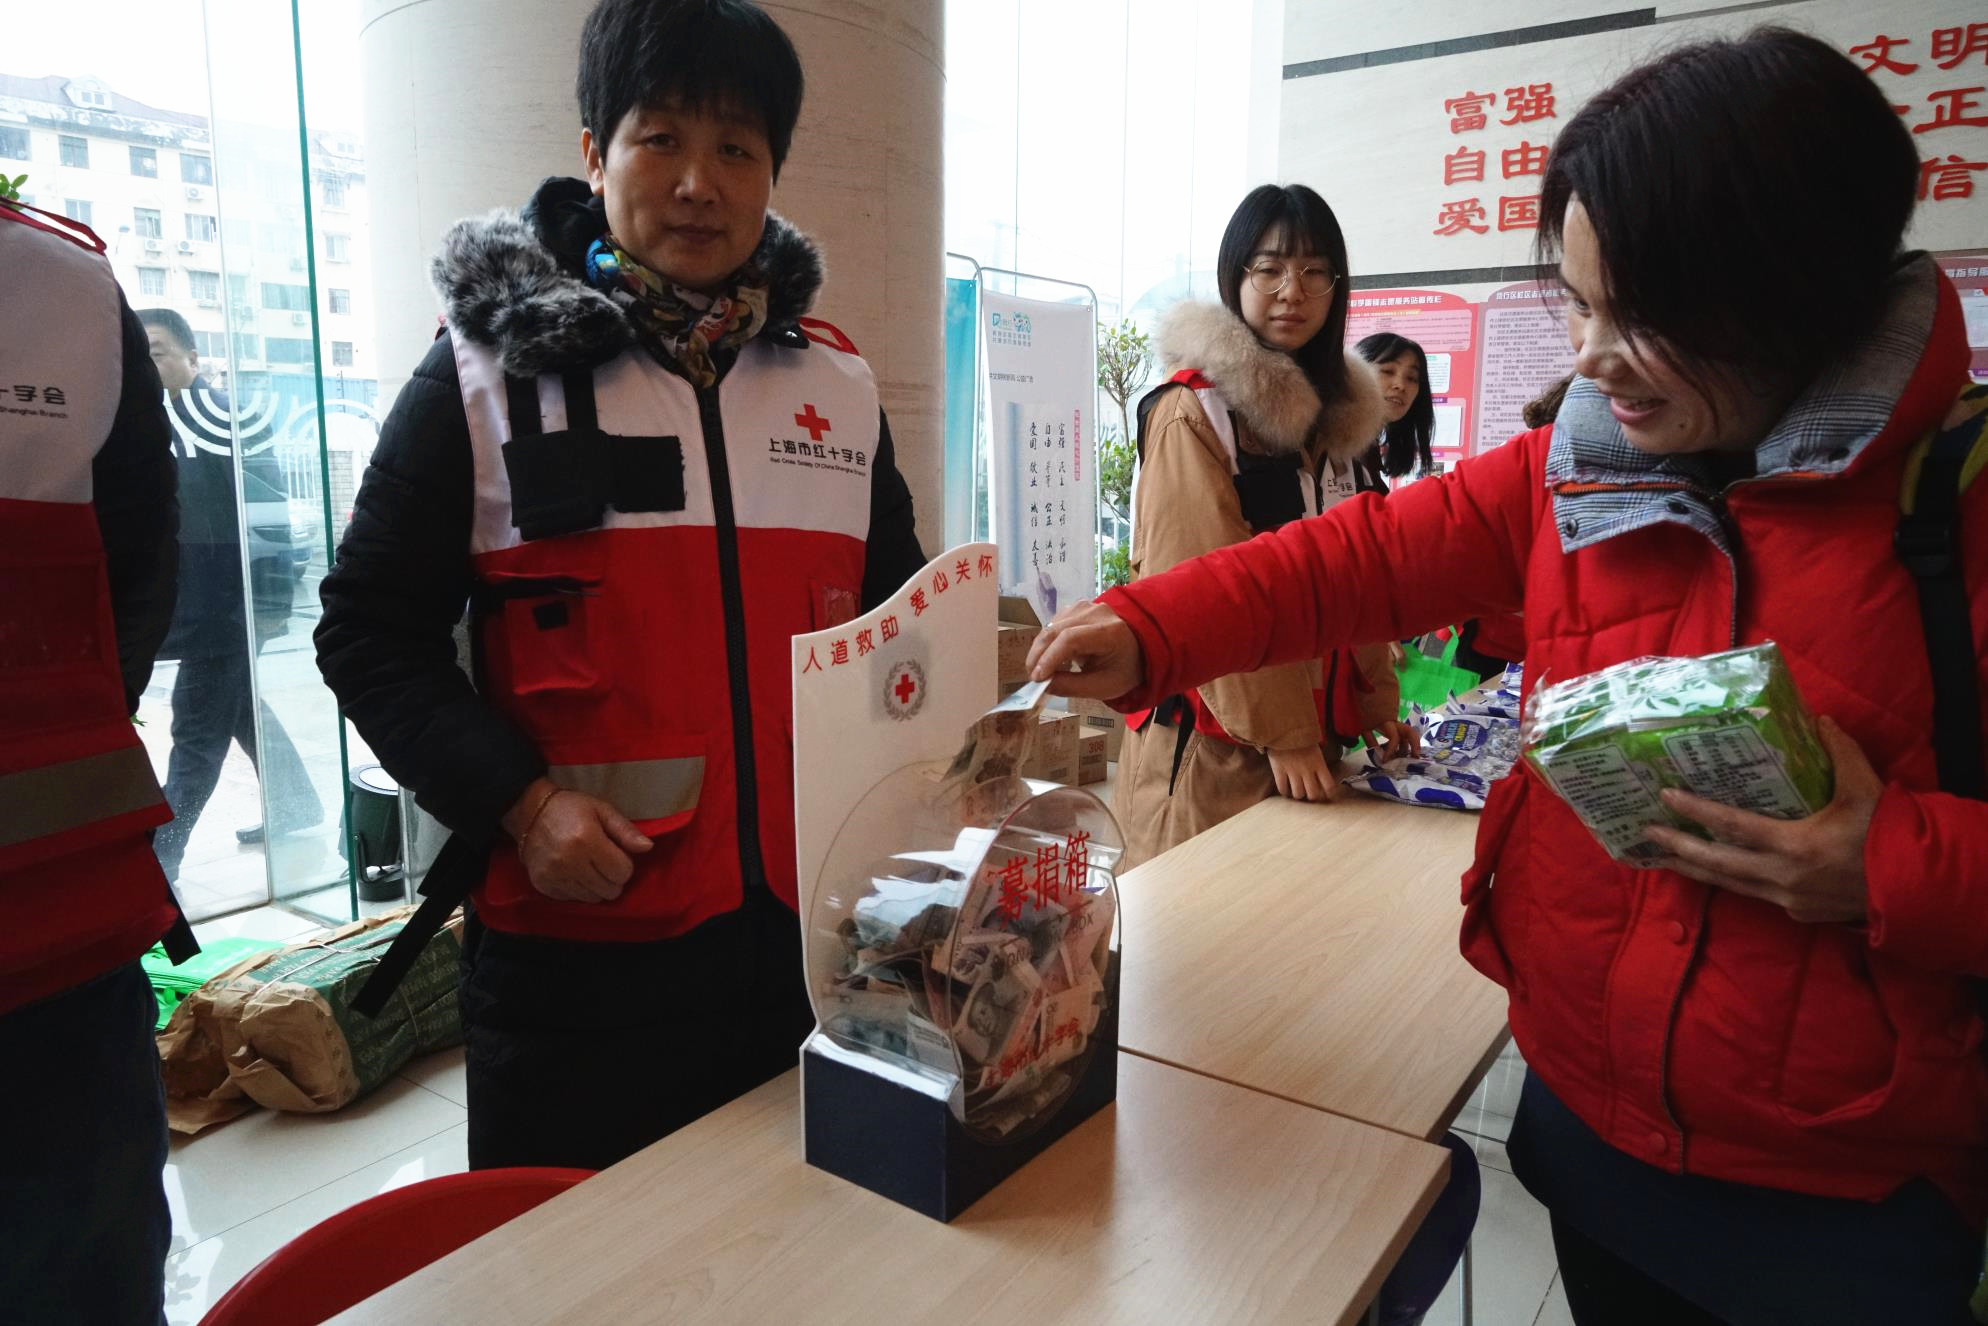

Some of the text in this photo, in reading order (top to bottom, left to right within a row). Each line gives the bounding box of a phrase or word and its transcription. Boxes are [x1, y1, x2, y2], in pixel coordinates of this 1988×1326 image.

[1849, 23, 1988, 75] 文明
[1444, 82, 1557, 134] 富强
[1888, 87, 1988, 134] 正
[1444, 141, 1550, 186] 自由
[1433, 194, 1542, 237] 爱国
[768, 437, 867, 466] 上海市红十字会
[802, 554, 993, 674] 人道救助 爱心关怀
[998, 829, 1090, 930] 募捐箱
